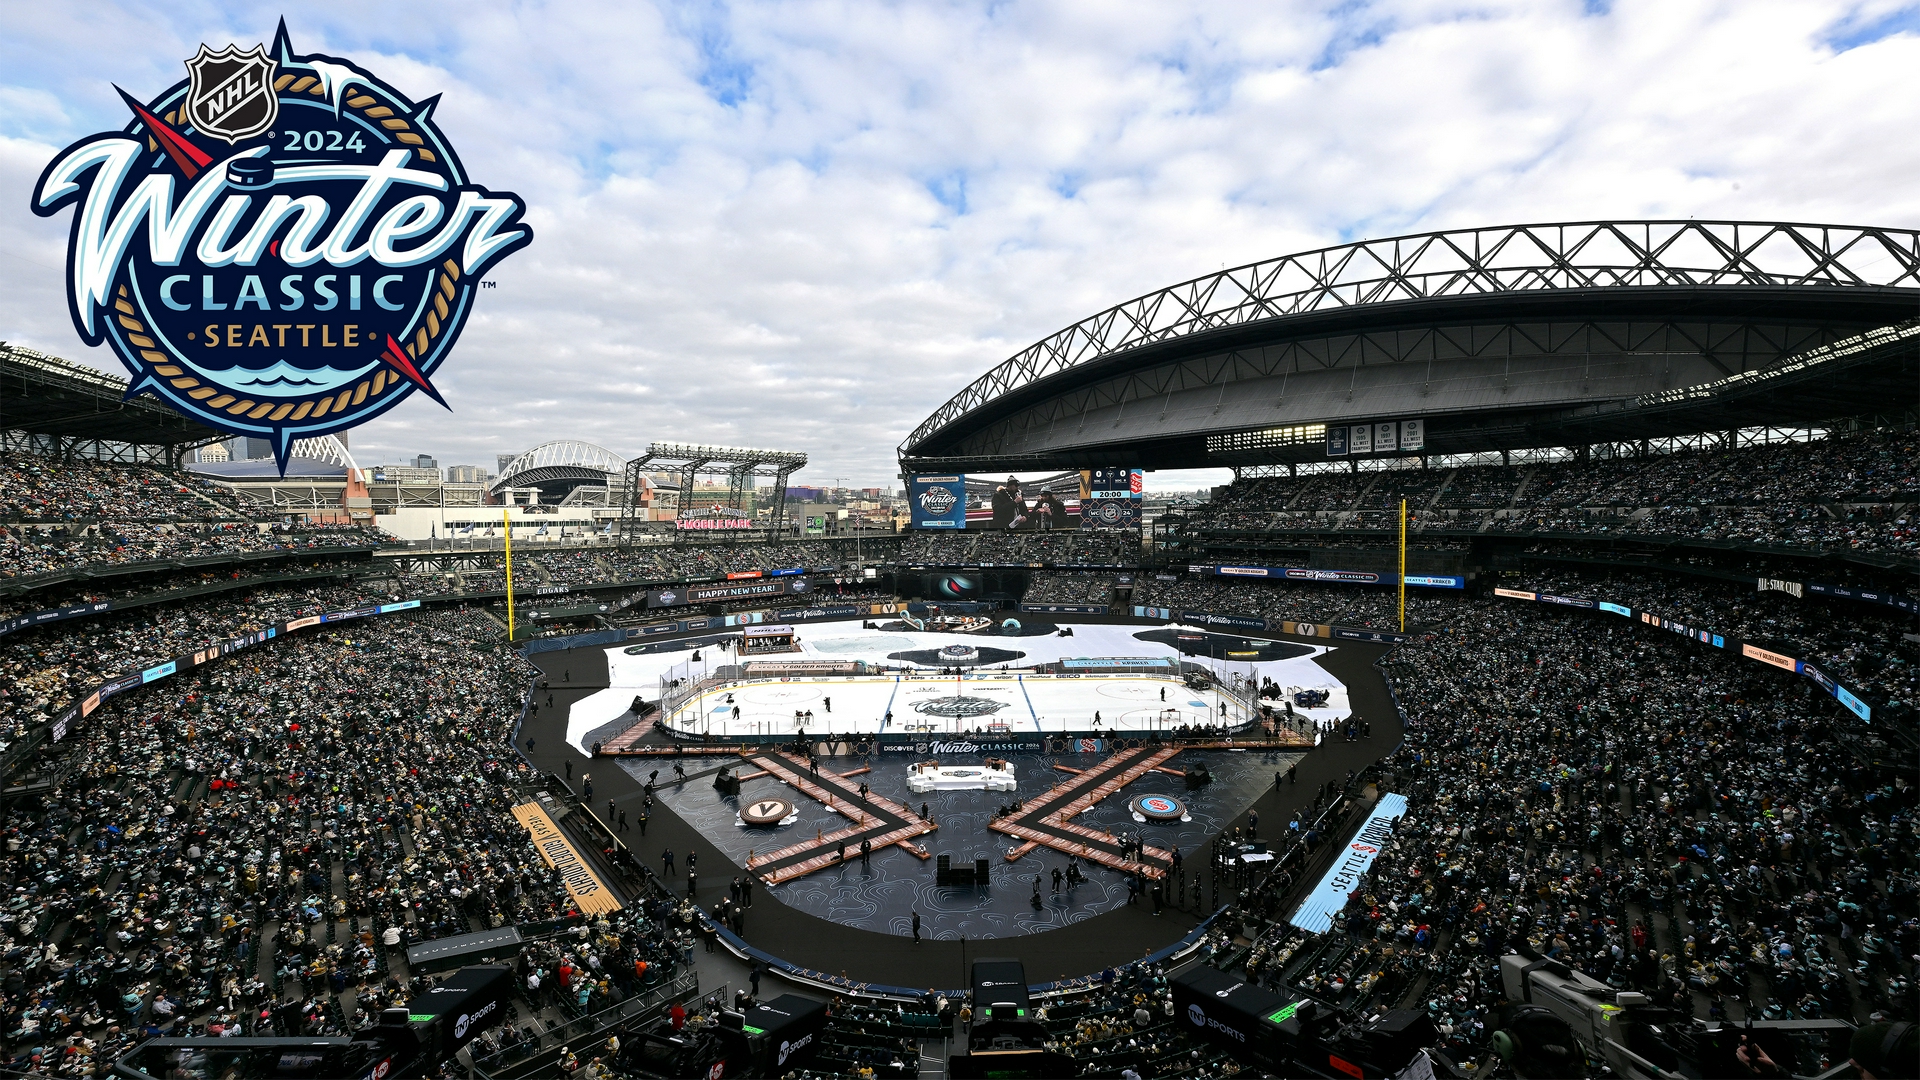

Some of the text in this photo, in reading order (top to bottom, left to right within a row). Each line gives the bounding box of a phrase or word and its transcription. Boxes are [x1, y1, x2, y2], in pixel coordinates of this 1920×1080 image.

[918, 493, 958, 508] Winter
[675, 519, 753, 530] T-MOBILE PARK
[698, 585, 775, 599] HAPPY NEW YEAR!
[1785, 582, 1802, 598] CLUB
[1206, 615, 1231, 624] Winter
[707, 684, 728, 693] DISCOVER
[929, 740, 980, 754] Winter
[529, 816, 550, 836] VEGAS
[542, 839, 576, 867] GOLDEN
[1330, 852, 1368, 890] SEATTLE
[455, 1000, 496, 1037] TNT SPORTS
[1188, 1006, 1245, 1042] TNT SPORTS
[789, 1034, 812, 1054] SPORTS
